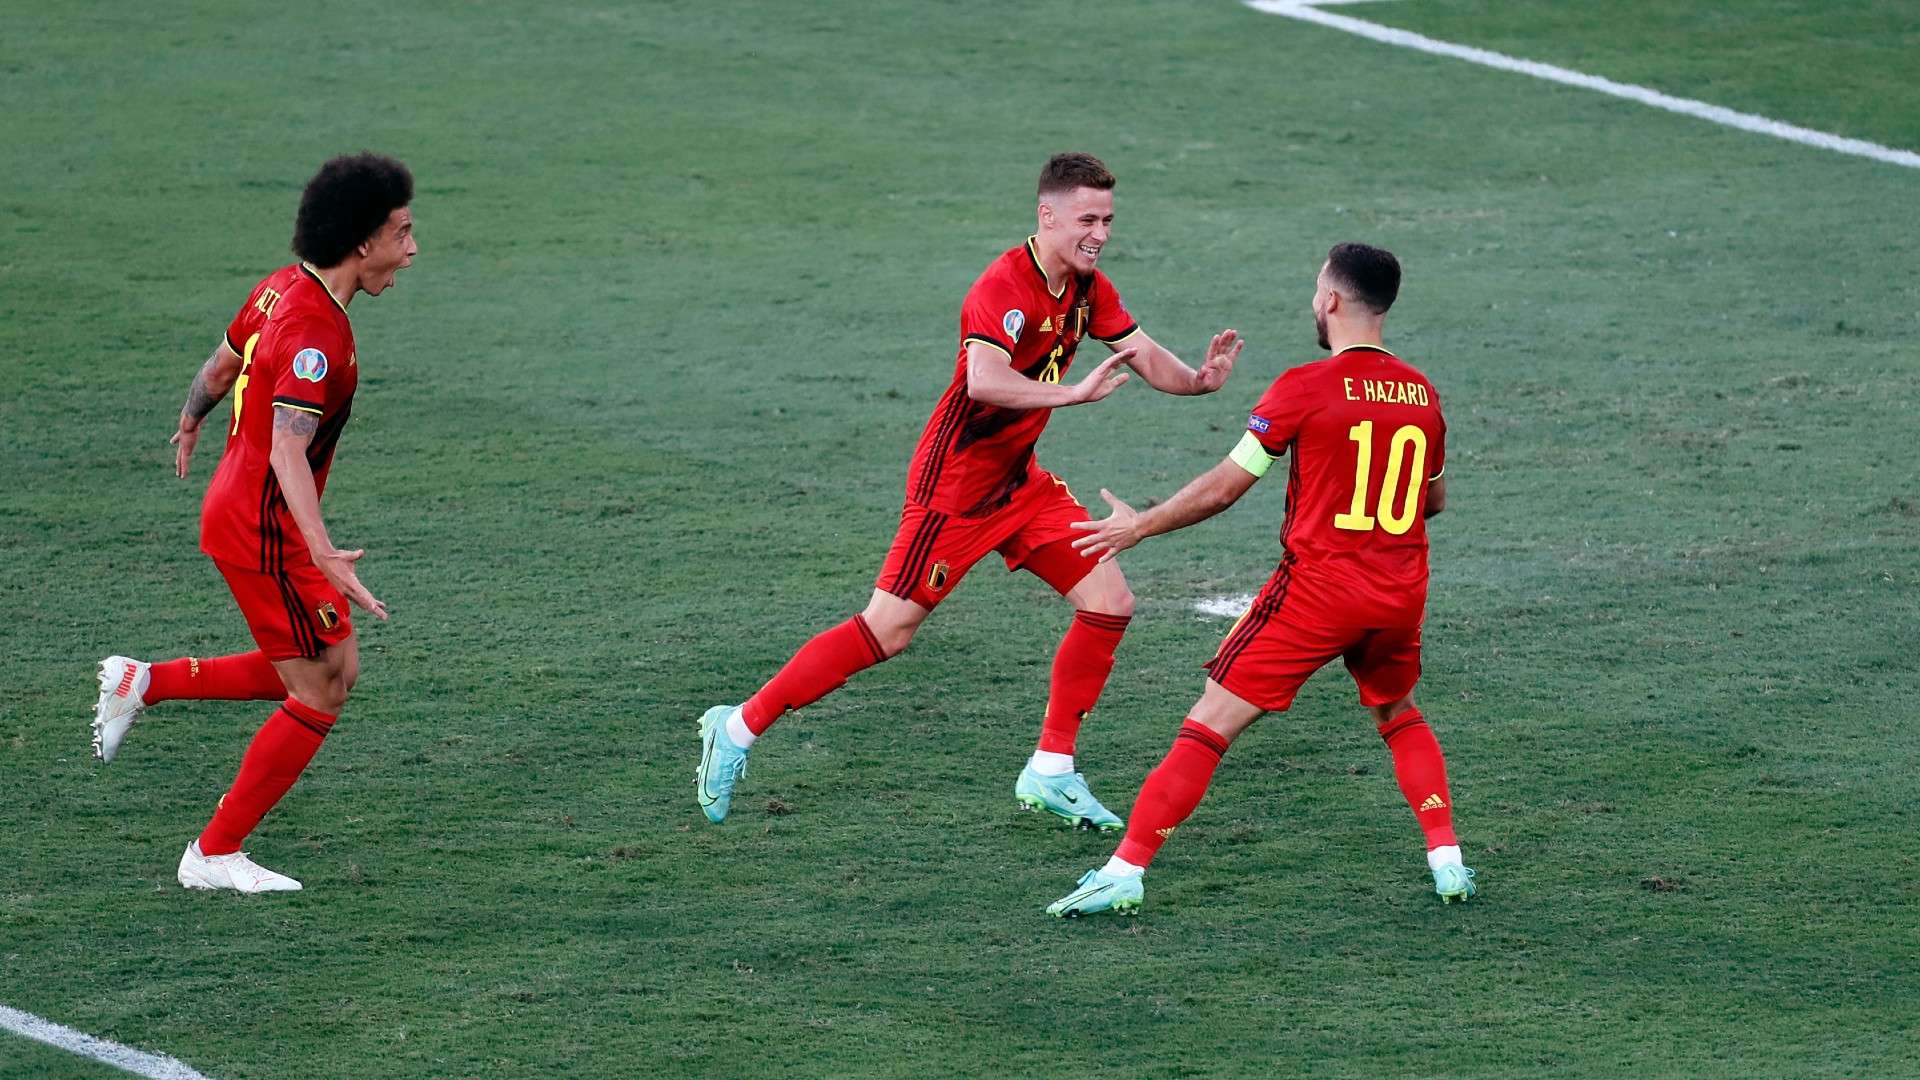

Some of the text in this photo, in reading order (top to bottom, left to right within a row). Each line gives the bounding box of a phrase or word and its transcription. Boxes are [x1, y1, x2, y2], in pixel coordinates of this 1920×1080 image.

[1343, 377, 1430, 407] E. HAZARD
[1333, 420, 1427, 536] 10
